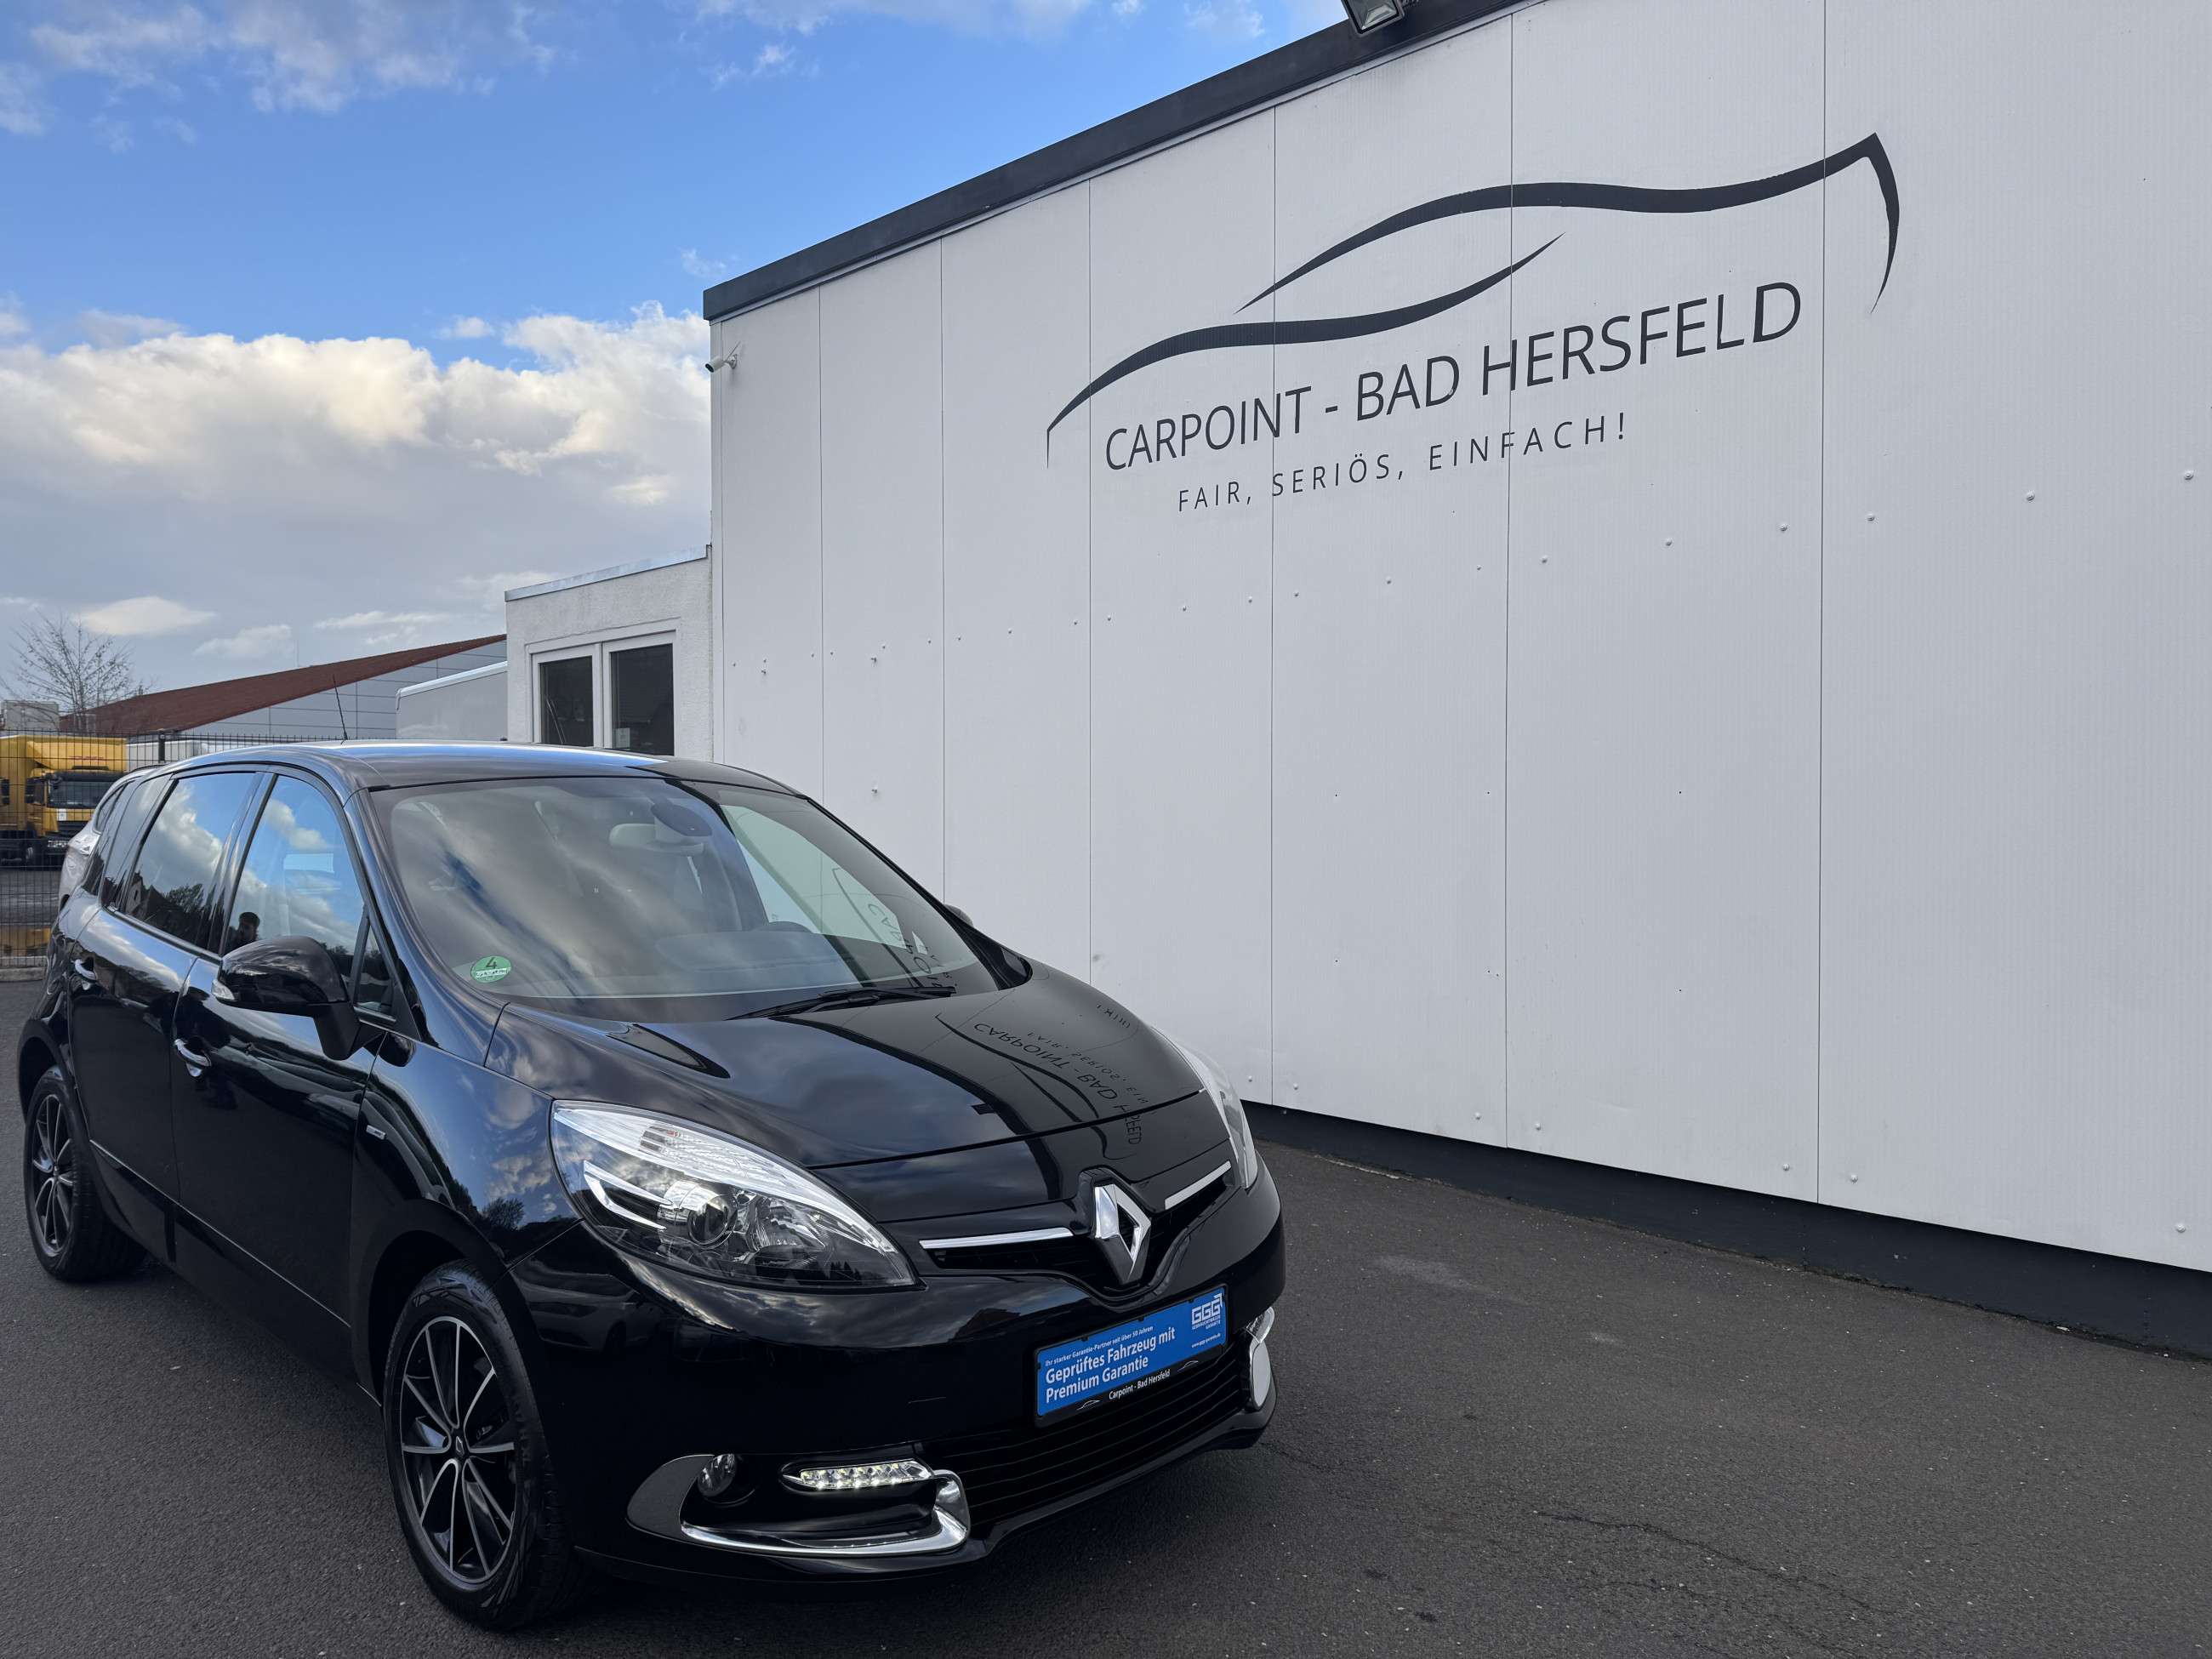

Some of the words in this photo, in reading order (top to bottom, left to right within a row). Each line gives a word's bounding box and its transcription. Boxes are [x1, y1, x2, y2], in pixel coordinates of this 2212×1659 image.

[1106, 385, 1312, 470] CARPOINT
[1325, 405, 1338, 413] -
[1357, 356, 1460, 420] BAD
[1482, 282, 1802, 396] HERSFELD
[1179, 482, 1251, 511] FAIR,
[1272, 453, 1403, 497] SERIÖS,
[1429, 413, 1624, 470] EINFACH!
[485, 956, 498, 969] 4
[1046, 1354, 1105, 1384] Geprüftes
[1108, 1336, 1157, 1364] Fahrzeug
[1159, 1326, 1176, 1345] mit
[1054, 1354, 1072, 1365] starker
[1072, 1340, 1112, 1359] Garantie-Partner
[1121, 1333, 1132, 1342] über
[1139, 1326, 1154, 1335] Jahren
[1046, 1375, 1099, 1404] Premium
[1102, 1355, 1149, 1382] Garantie
[1109, 1384, 1133, 1400] Carpoint
[1137, 1377, 1149, 1389] Bad
[1149, 1369, 1171, 1384] Hersfeld
